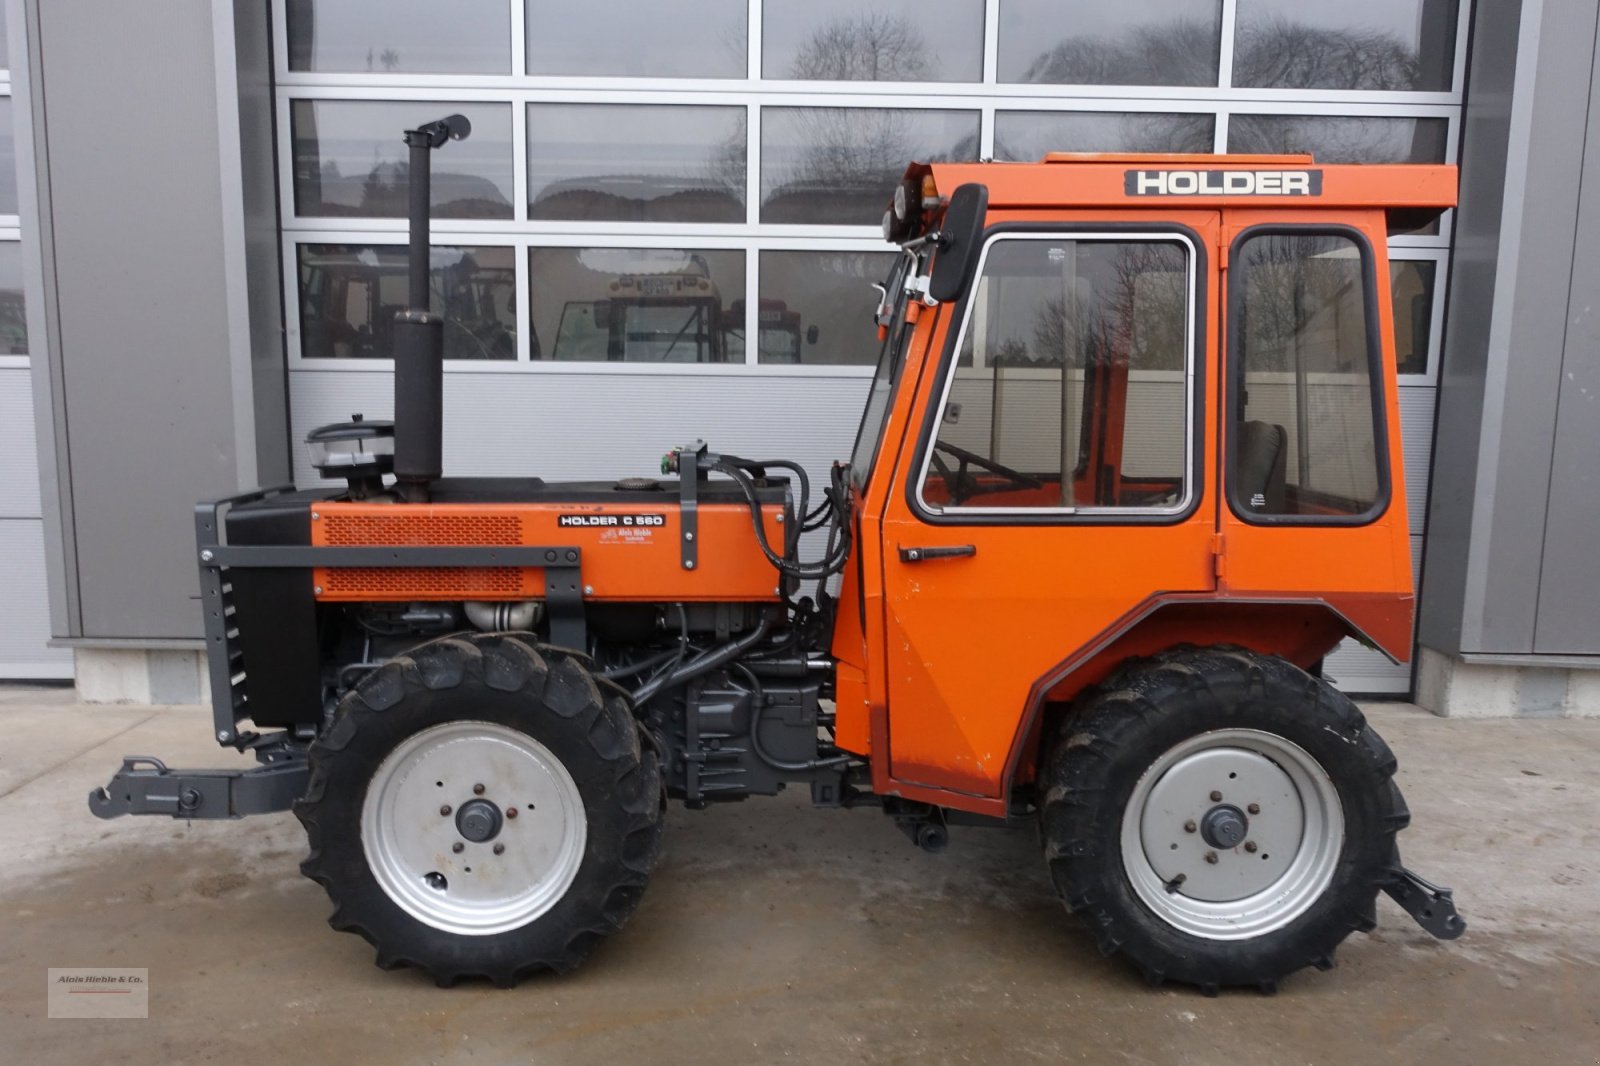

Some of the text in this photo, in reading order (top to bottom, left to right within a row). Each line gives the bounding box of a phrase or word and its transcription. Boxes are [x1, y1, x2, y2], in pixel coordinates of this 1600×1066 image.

[1137, 171, 1310, 195] HOLDER
[561, 516, 663, 526] HOLDER C 560
